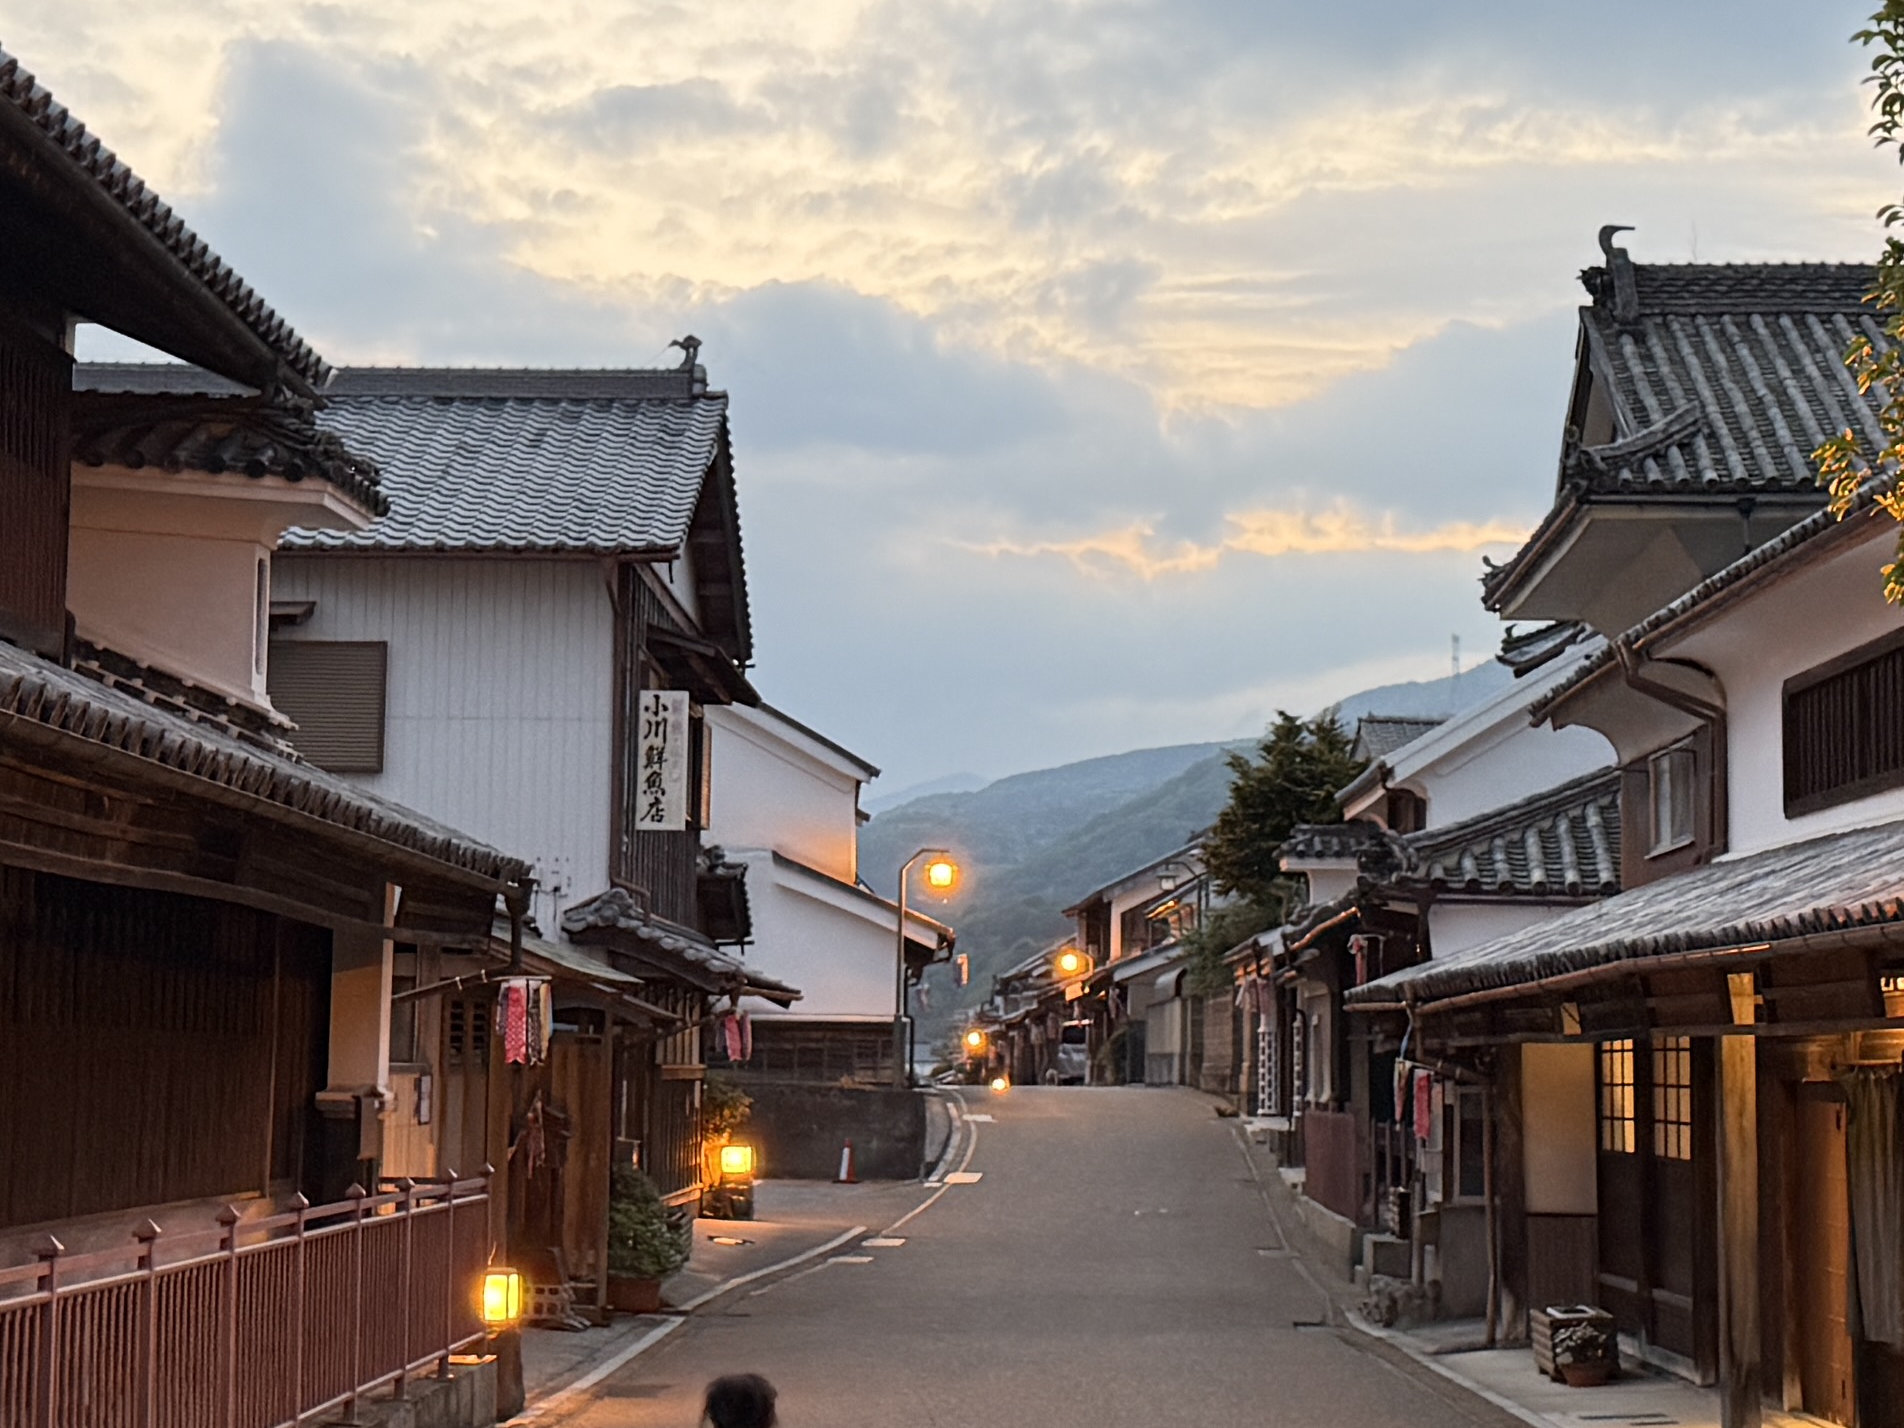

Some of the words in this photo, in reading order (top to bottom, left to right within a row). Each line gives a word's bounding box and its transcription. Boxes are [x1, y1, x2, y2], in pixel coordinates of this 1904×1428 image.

[640, 694, 669, 823] 小川鮮魚店
